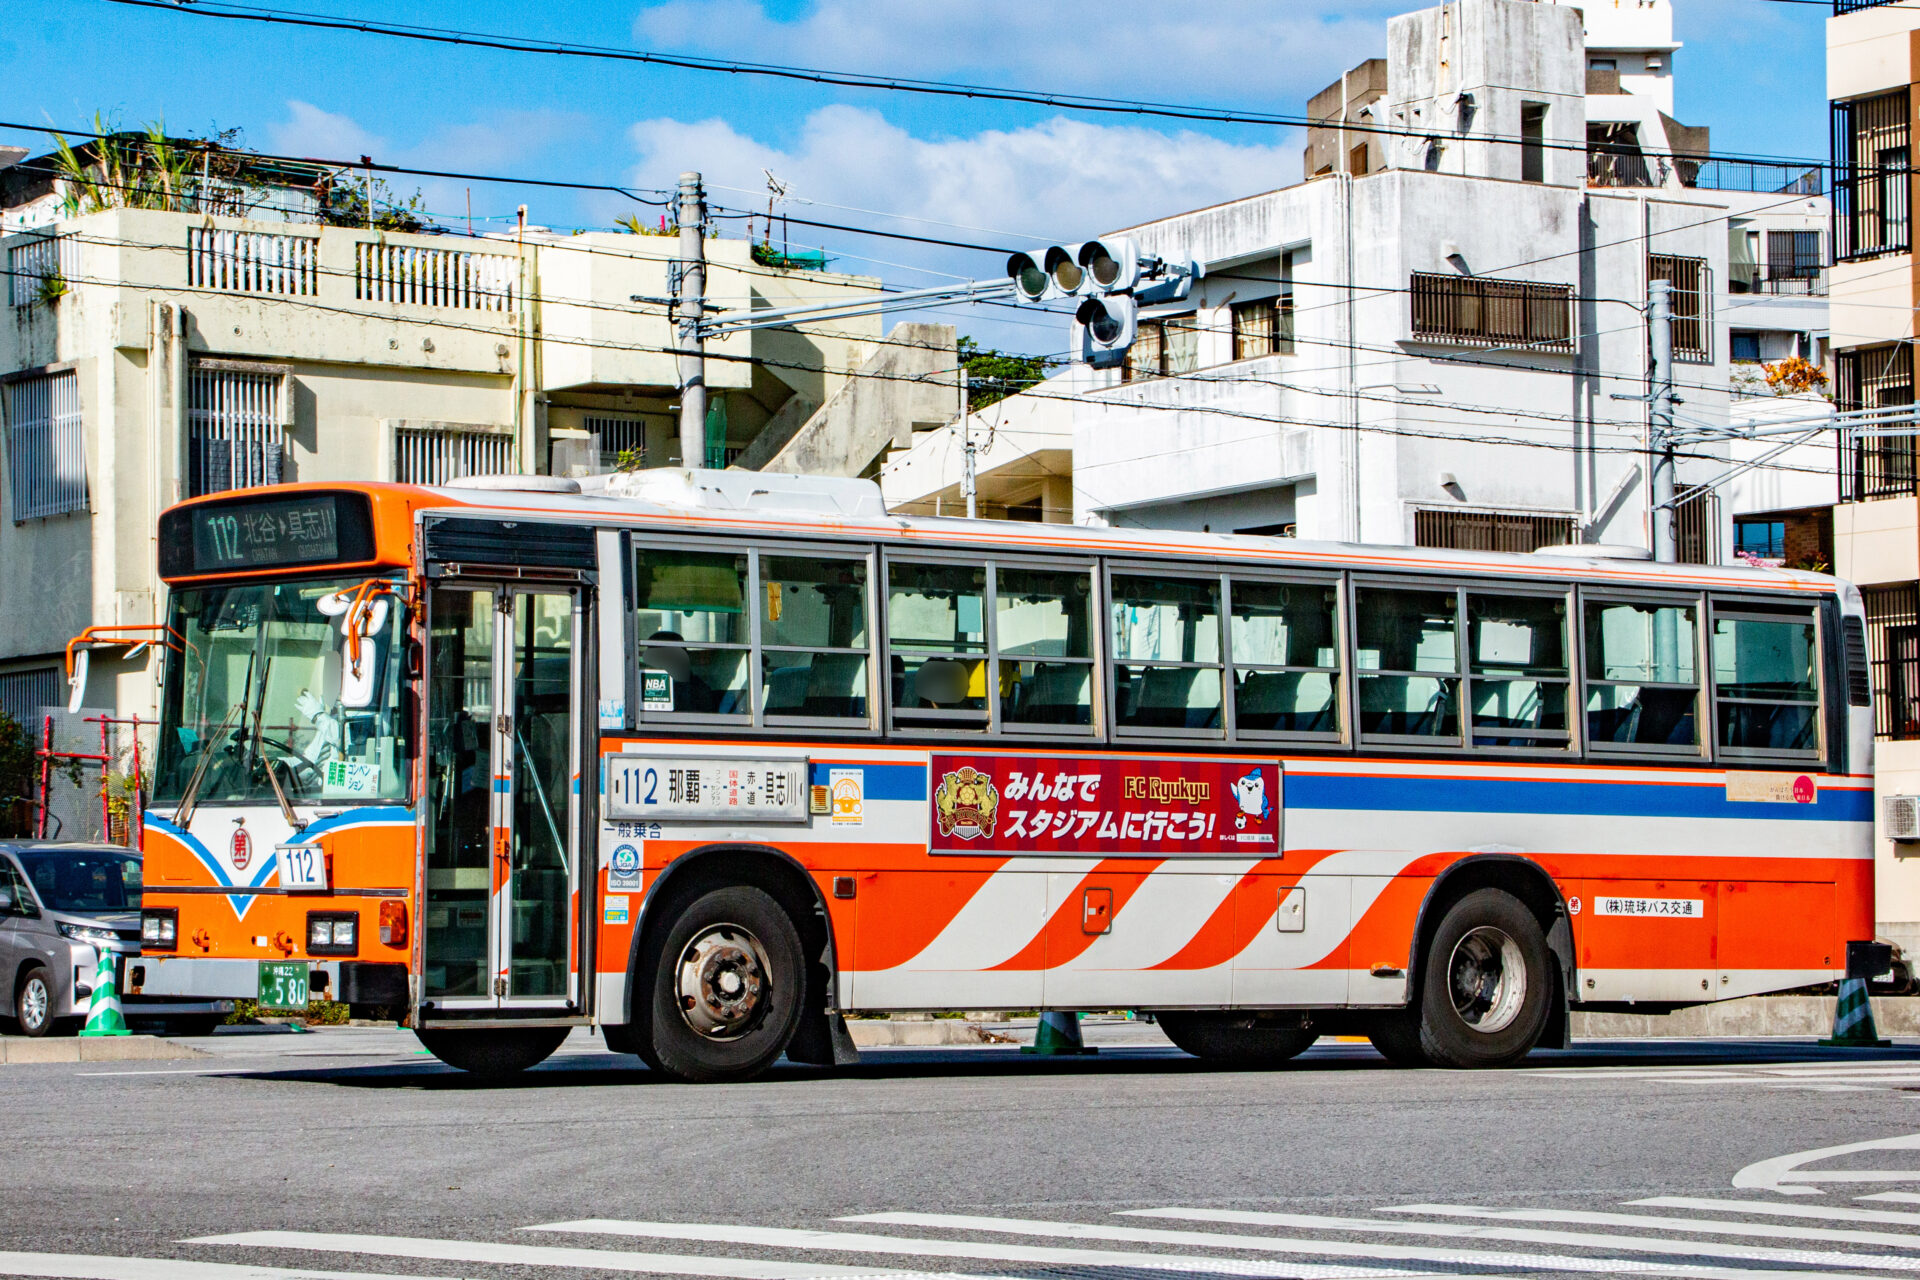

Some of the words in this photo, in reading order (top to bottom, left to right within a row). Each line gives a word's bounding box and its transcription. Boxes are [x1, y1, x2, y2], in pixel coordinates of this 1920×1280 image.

[207, 515, 244, 561] 112
[242, 511, 277, 545] 北谷
[287, 507, 337, 542] 具志川
[645, 678, 667, 691] NBA
[623, 767, 658, 805] 112
[668, 769, 701, 804] 那覇
[728, 769, 739, 806] 国体道路
[747, 771, 756, 806] 赤道
[765, 770, 798, 807] 具志川
[1004, 772, 1101, 802] みんなで
[1125, 776, 1146, 798] FC
[1149, 776, 1210, 804] Ryukyu
[603, 821, 662, 839] 一般乗合
[1003, 809, 1216, 841] スタジアムに行こう!
[233, 832, 247, 863] 第一
[286, 848, 316, 883] 112
[610, 879, 622, 887] ISO
[1605, 899, 1693, 915] (株)琉球バス交通
